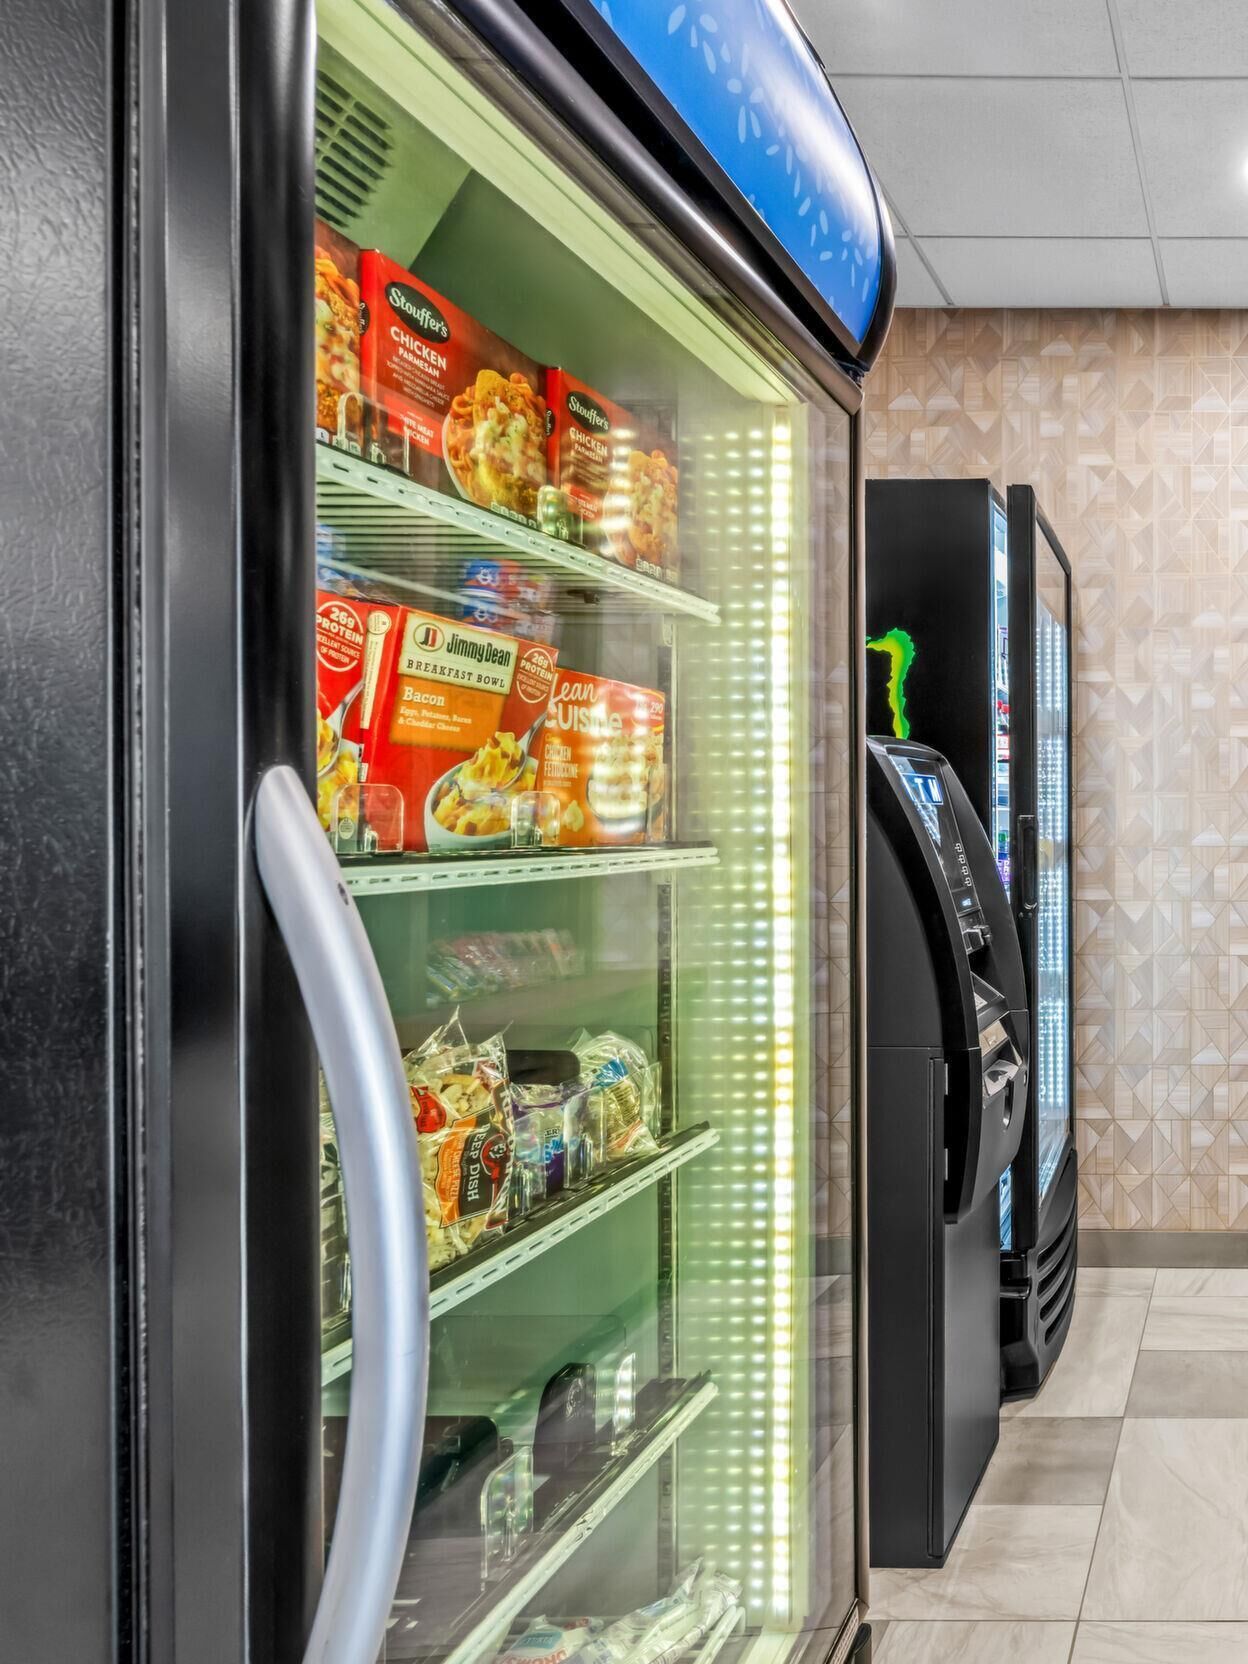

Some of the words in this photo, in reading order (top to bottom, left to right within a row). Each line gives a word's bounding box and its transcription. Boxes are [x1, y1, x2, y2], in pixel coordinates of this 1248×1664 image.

[389, 287, 448, 338] Stouffer's
[390, 326, 447, 371] CHICKEN
[398, 346, 440, 378] PARMESAN
[568, 395, 609, 431] Stouffer's
[569, 427, 608, 457] CHICKEN
[574, 443, 603, 464] PARMESAN
[316, 613, 364, 645] PROTEIN
[329, 606, 355, 629] 26g
[446, 633, 486, 664] Jimmy
[484, 642, 511, 667] Dean
[532, 652, 549, 669] 26g
[406, 659, 474, 681] BREAKFAST
[476, 673, 505, 688] BOWL
[520, 659, 552, 681] PROTEIN
[402, 686, 446, 707] Bacon
[544, 743, 572, 761] CHICKEN
[469, 1123, 491, 1160] DEEP
[466, 1163, 481, 1201] DISH
